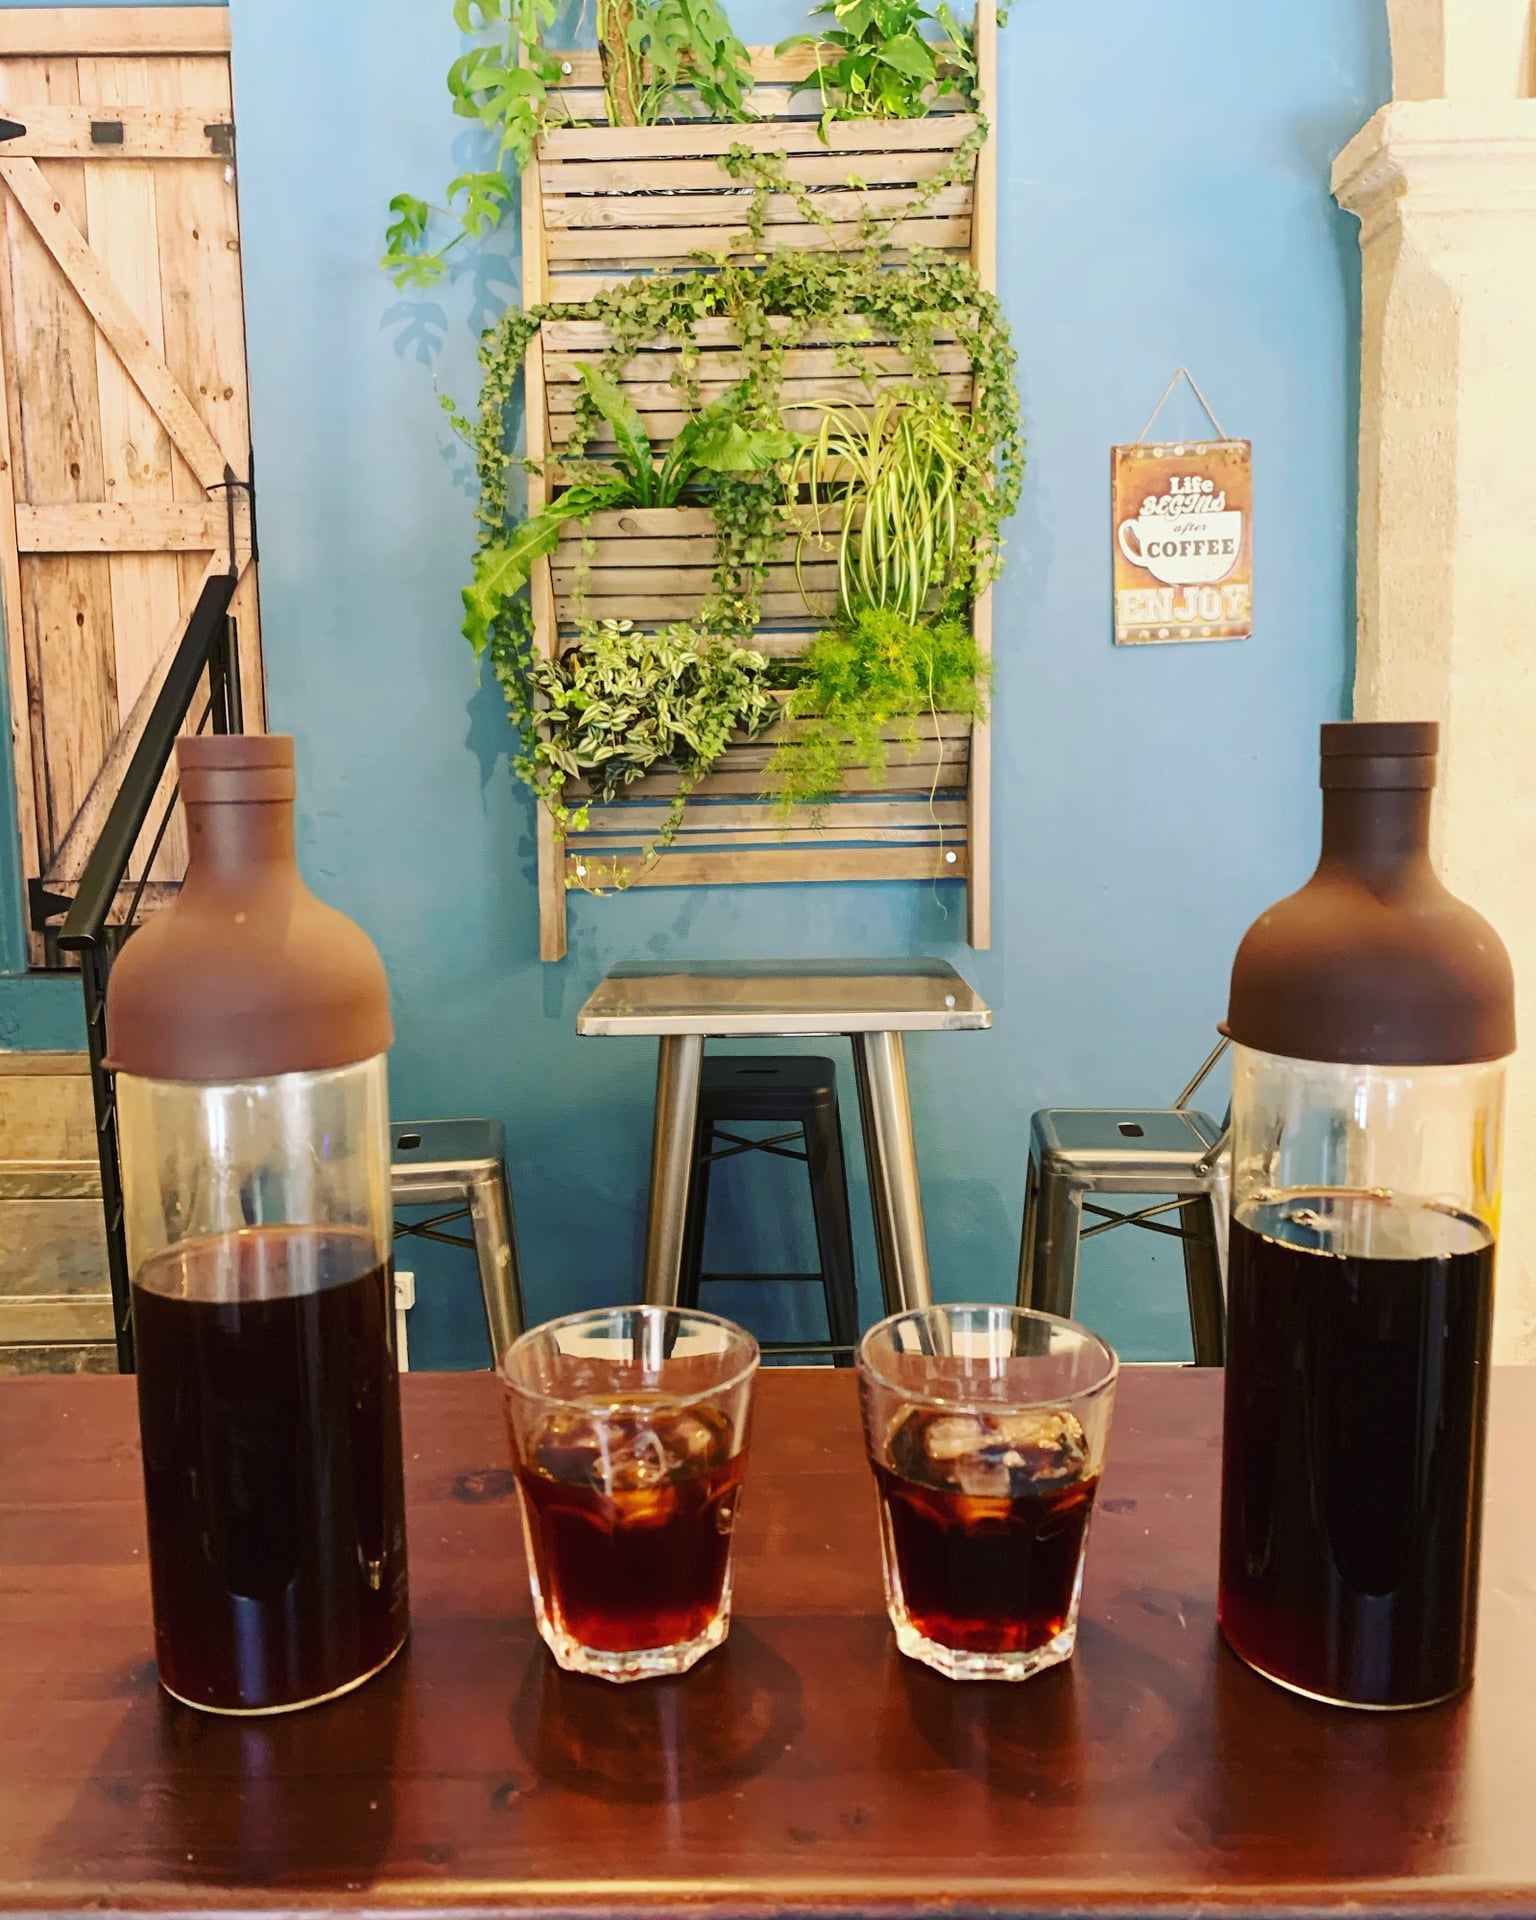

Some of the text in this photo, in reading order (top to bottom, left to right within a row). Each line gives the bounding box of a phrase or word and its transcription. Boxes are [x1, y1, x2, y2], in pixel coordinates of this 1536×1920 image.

[1169, 476, 1214, 494] Life
[1173, 522, 1207, 535] after
[1147, 539, 1234, 558] COFFEE
[1119, 584, 1249, 624] ENJOY
